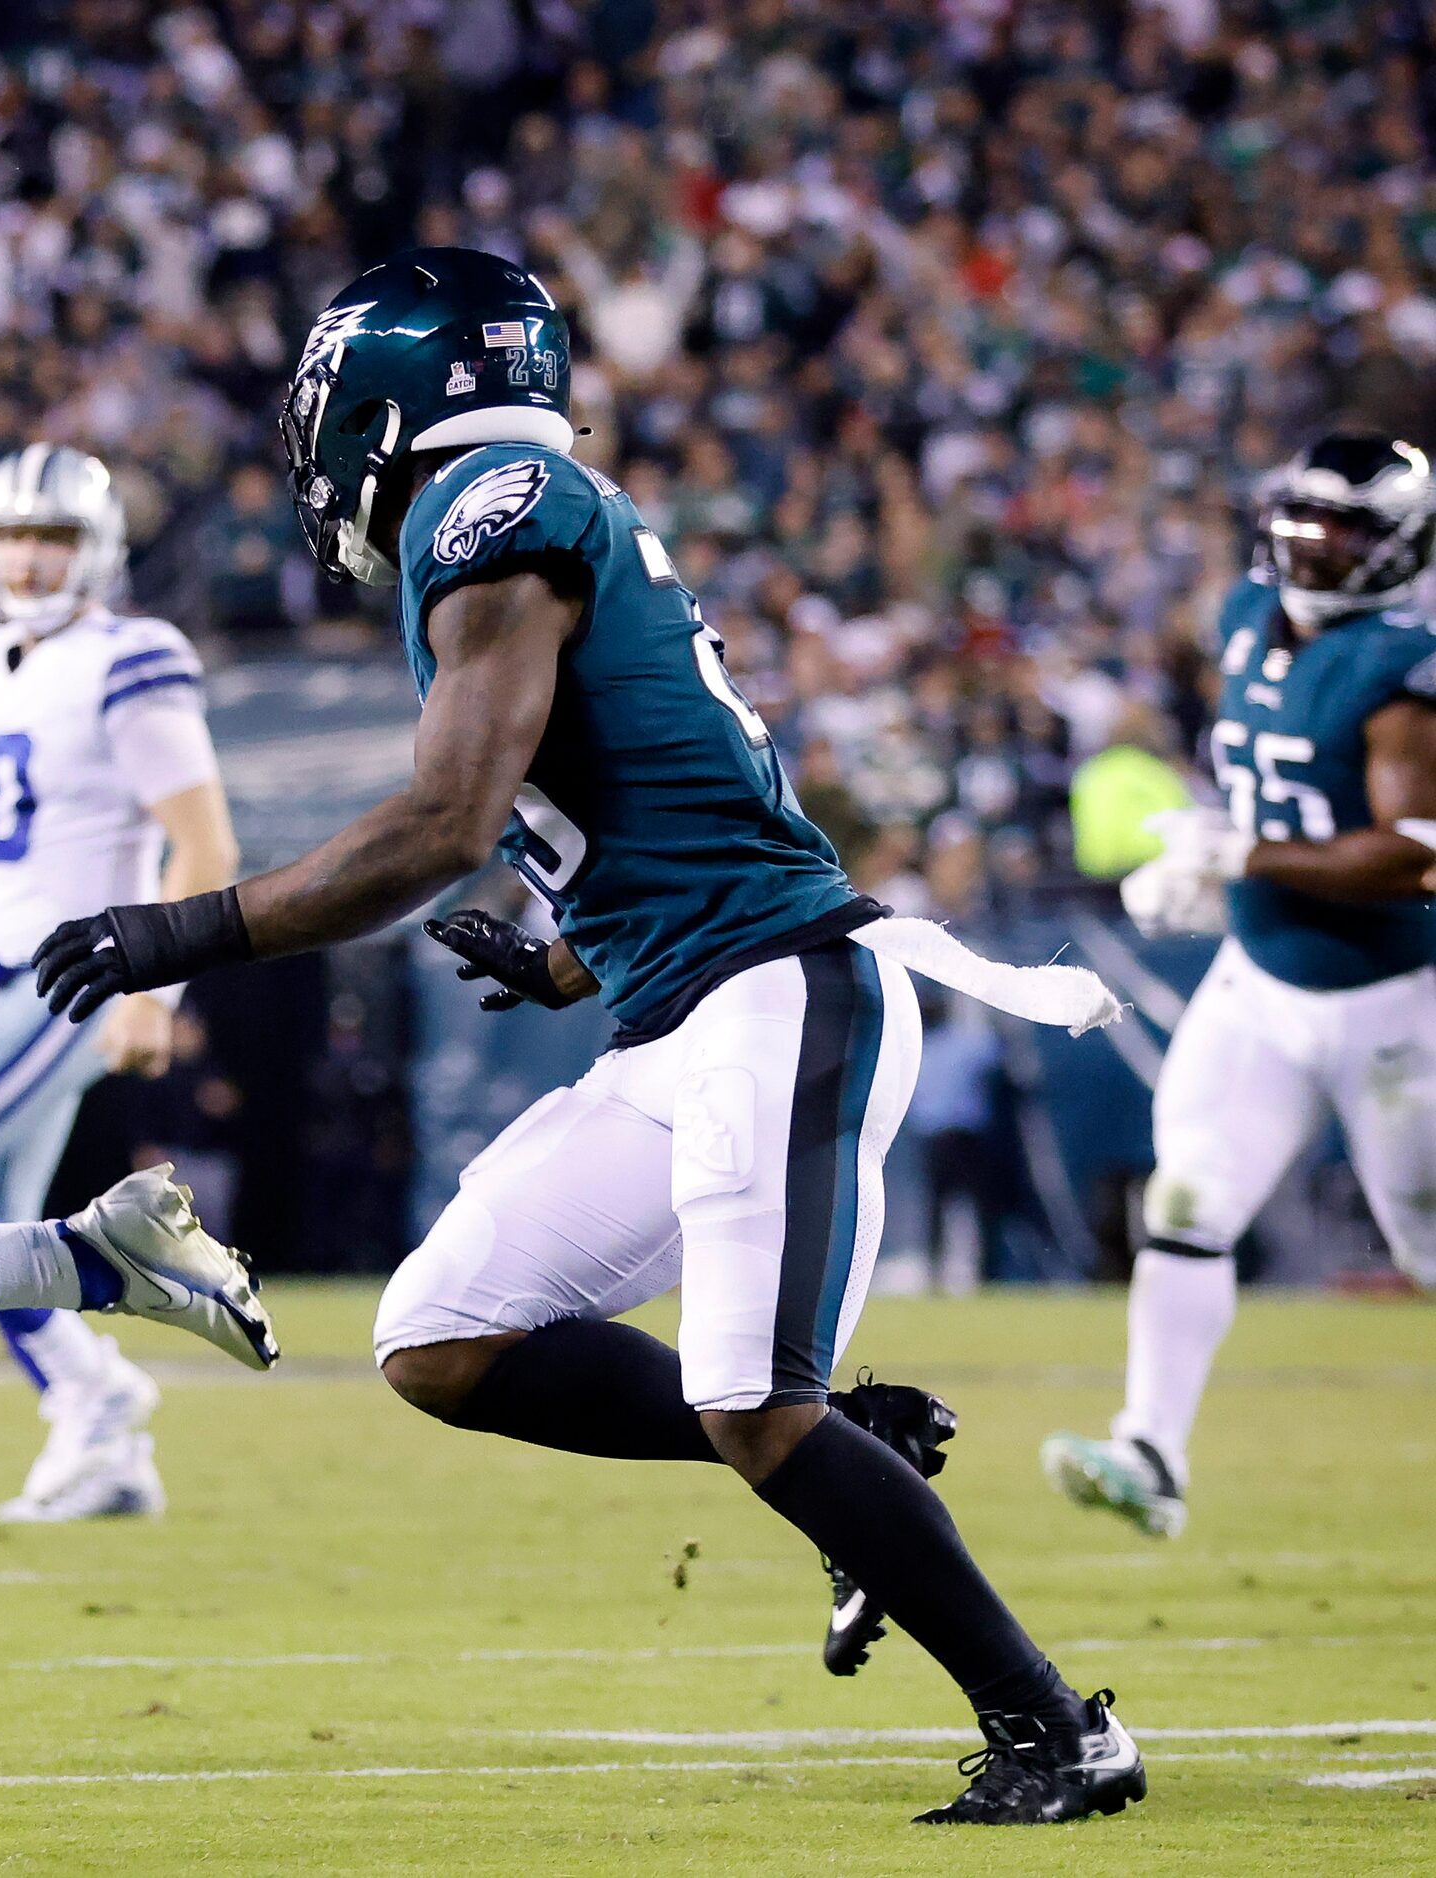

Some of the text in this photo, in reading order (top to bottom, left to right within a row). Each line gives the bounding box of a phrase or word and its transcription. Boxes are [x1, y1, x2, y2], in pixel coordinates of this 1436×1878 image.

[448, 378, 474, 392] CATCH
[506, 346, 558, 390] 23
[1210, 717, 1337, 846] 55
